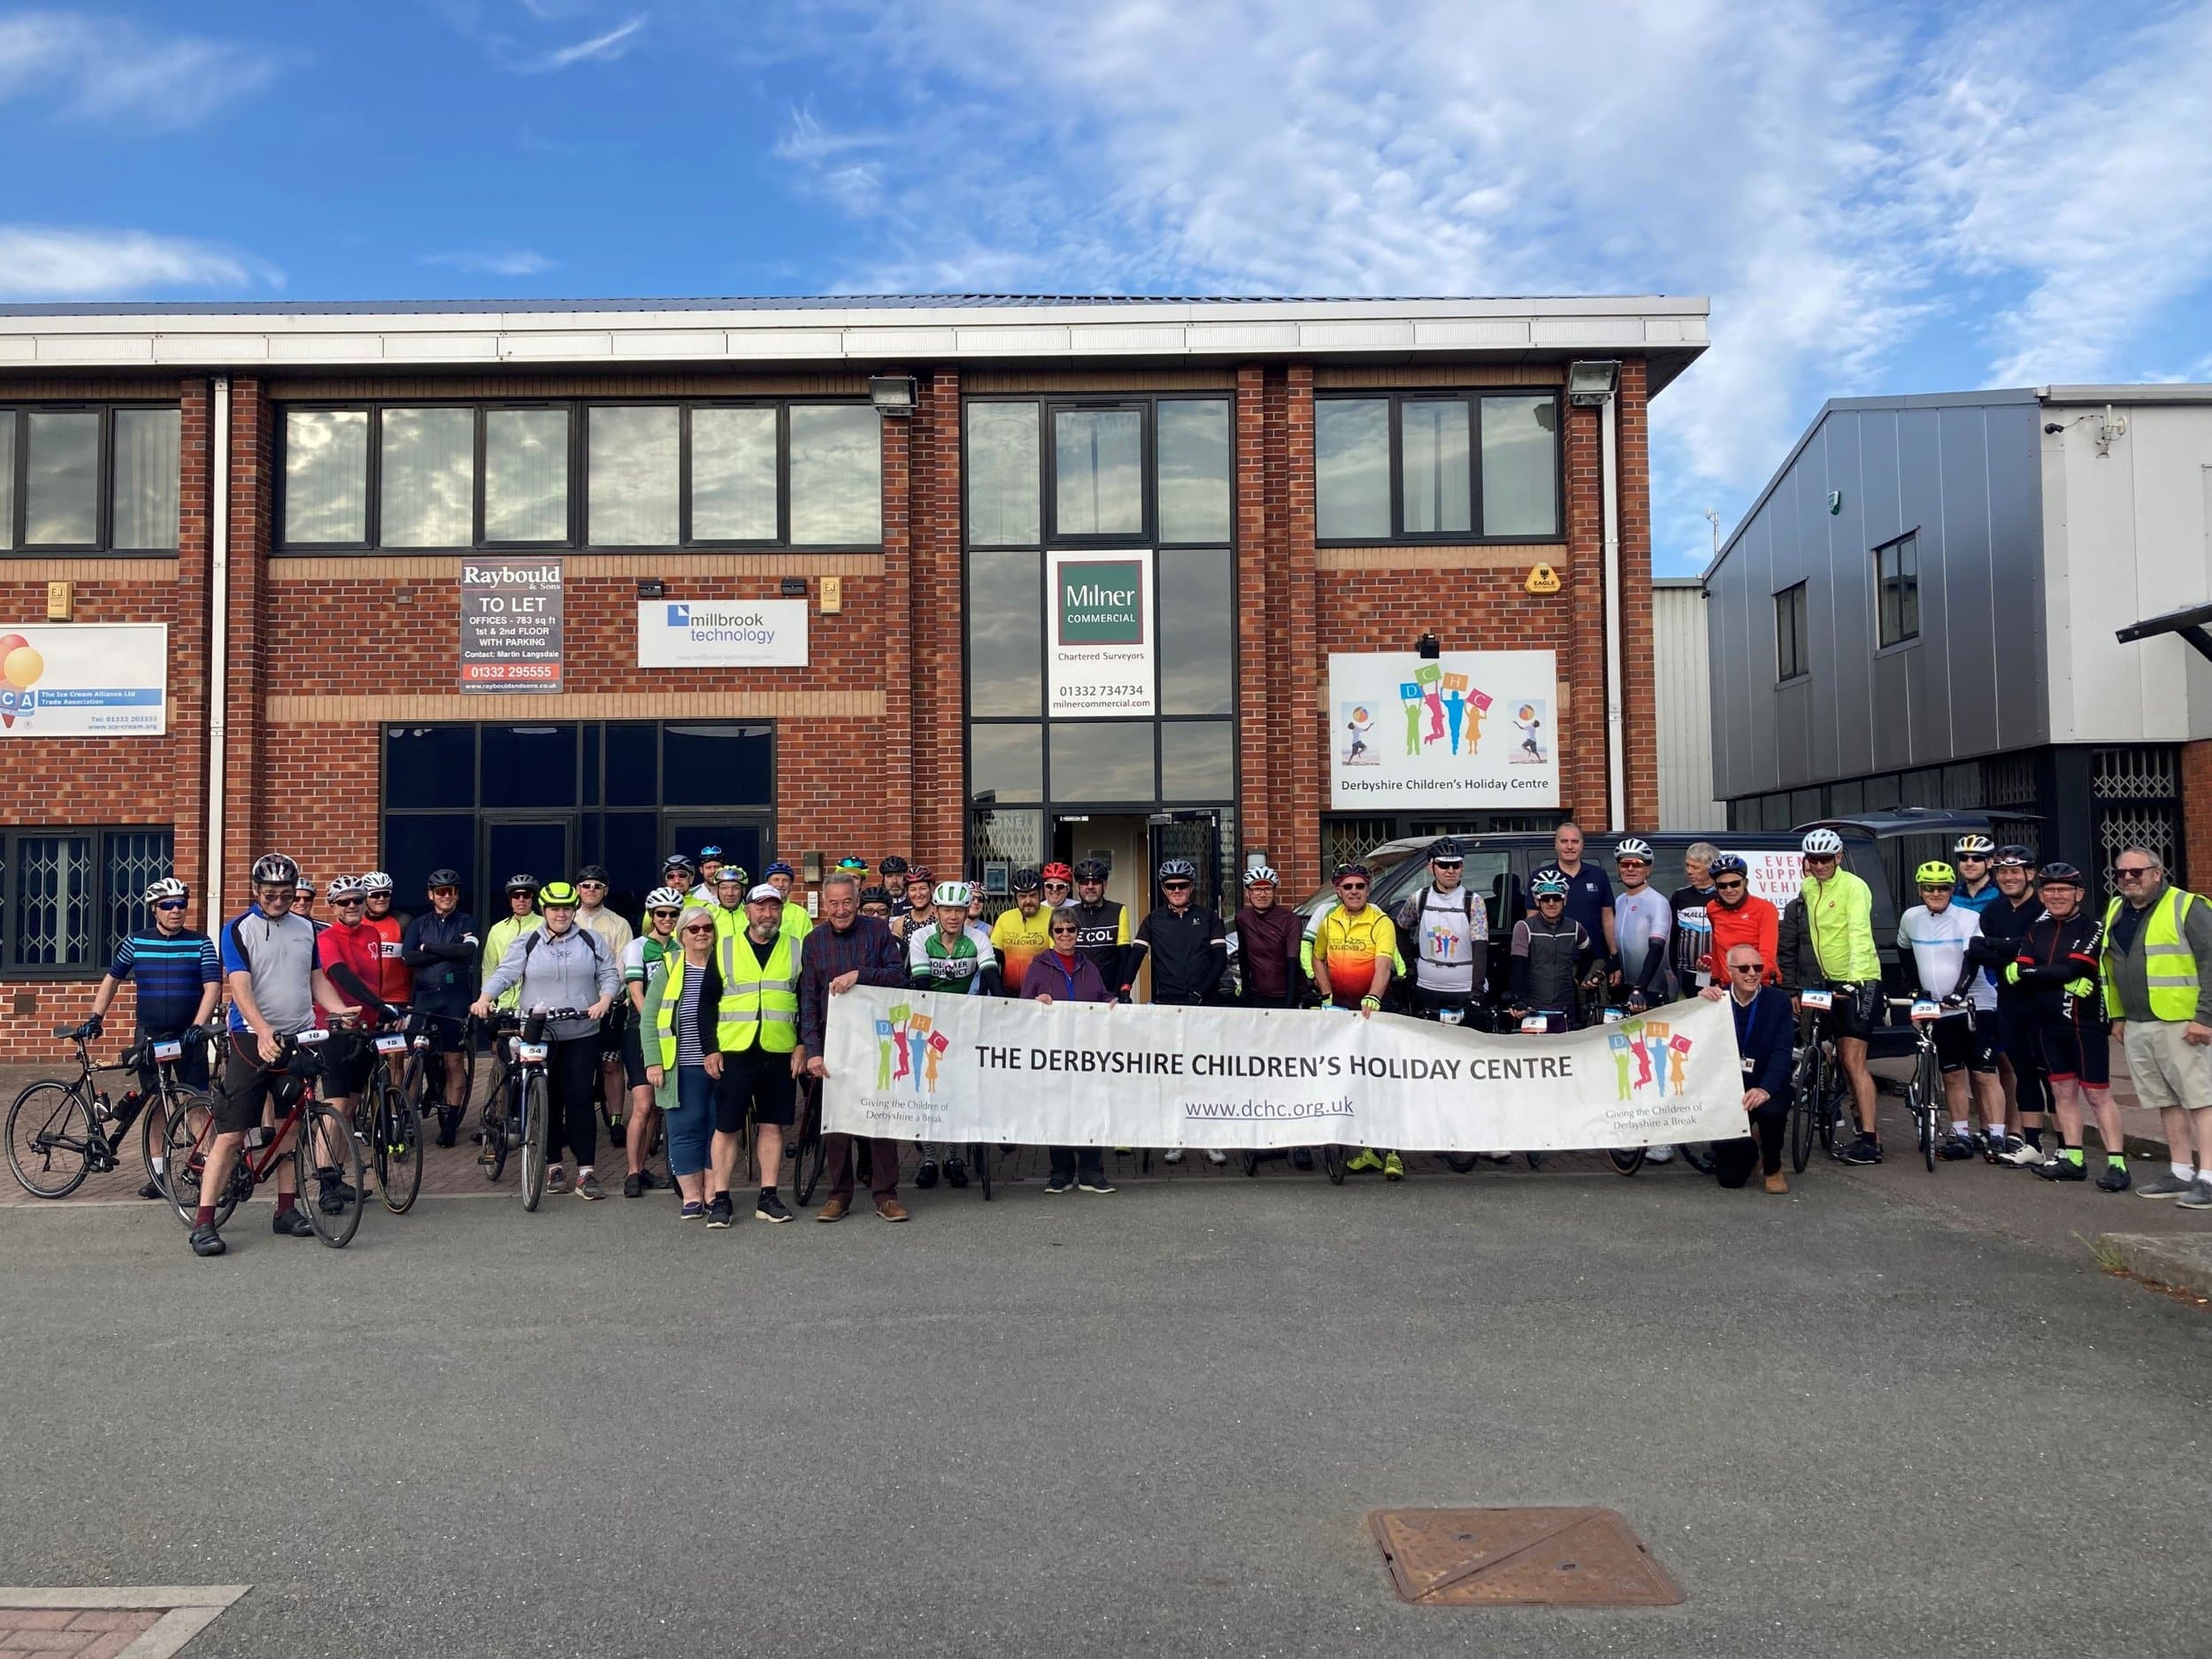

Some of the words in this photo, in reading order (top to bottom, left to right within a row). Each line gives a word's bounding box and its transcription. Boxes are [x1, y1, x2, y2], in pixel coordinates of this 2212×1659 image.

[464, 566, 560, 588] Raybould
[1067, 584, 1135, 607] Milner
[479, 597, 504, 612] TO
[511, 597, 547, 612] LET
[534, 618, 546, 626] sq
[549, 616, 556, 625] ft
[690, 613, 764, 626] millbrook
[1067, 614, 1136, 623] COMMERCIAL
[691, 628, 775, 644] technology
[522, 650, 559, 659] Langsdale
[1058, 652, 1100, 661] Chartered
[1102, 651, 1144, 661] Surveyors
[471, 666, 504, 678] 01332
[508, 666, 552, 678] 295555
[1060, 686, 1096, 697] 01332
[1100, 685, 1143, 696] 734734
[1407, 685, 1417, 697] D
[1422, 667, 1432, 681] C
[1450, 676, 1461, 687] H
[1474, 694, 1486, 706] C
[1053, 699, 1150, 709] milnercommercial.com
[1341, 780, 1402, 793] Derbyshire
[1405, 779, 1462, 791] Children’s
[1464, 779, 1508, 792] Holiday
[1510, 779, 1548, 789] Centre
[1765, 856, 1804, 867] EVEN
[1759, 881, 1797, 893] VEHI
[1087, 931, 1113, 942] COL
[975, 1046, 1022, 1070] THE
[1030, 1048, 1184, 1075] DERBYSHIRE
[1192, 1054, 1341, 1078] CHILDREN’S
[1349, 1055, 1462, 1079] HOLIDAY
[1470, 1056, 1573, 1079] CENTRE
[860, 1097, 889, 1110] Giving
[892, 1099, 906, 1108] the
[907, 1100, 939, 1110] Children
[1186, 1095, 1354, 1118] www.dchc.org.uk
[866, 1110, 913, 1122] Derbyshire
[1605, 1110, 1634, 1119] Giving
[1637, 1108, 1650, 1117] the
[1652, 1104, 1691, 1115] Children
[1694, 1102, 1702, 1111] of
[1613, 1118, 1662, 1131] Derbyshire
[1671, 1116, 1697, 1125] Break
